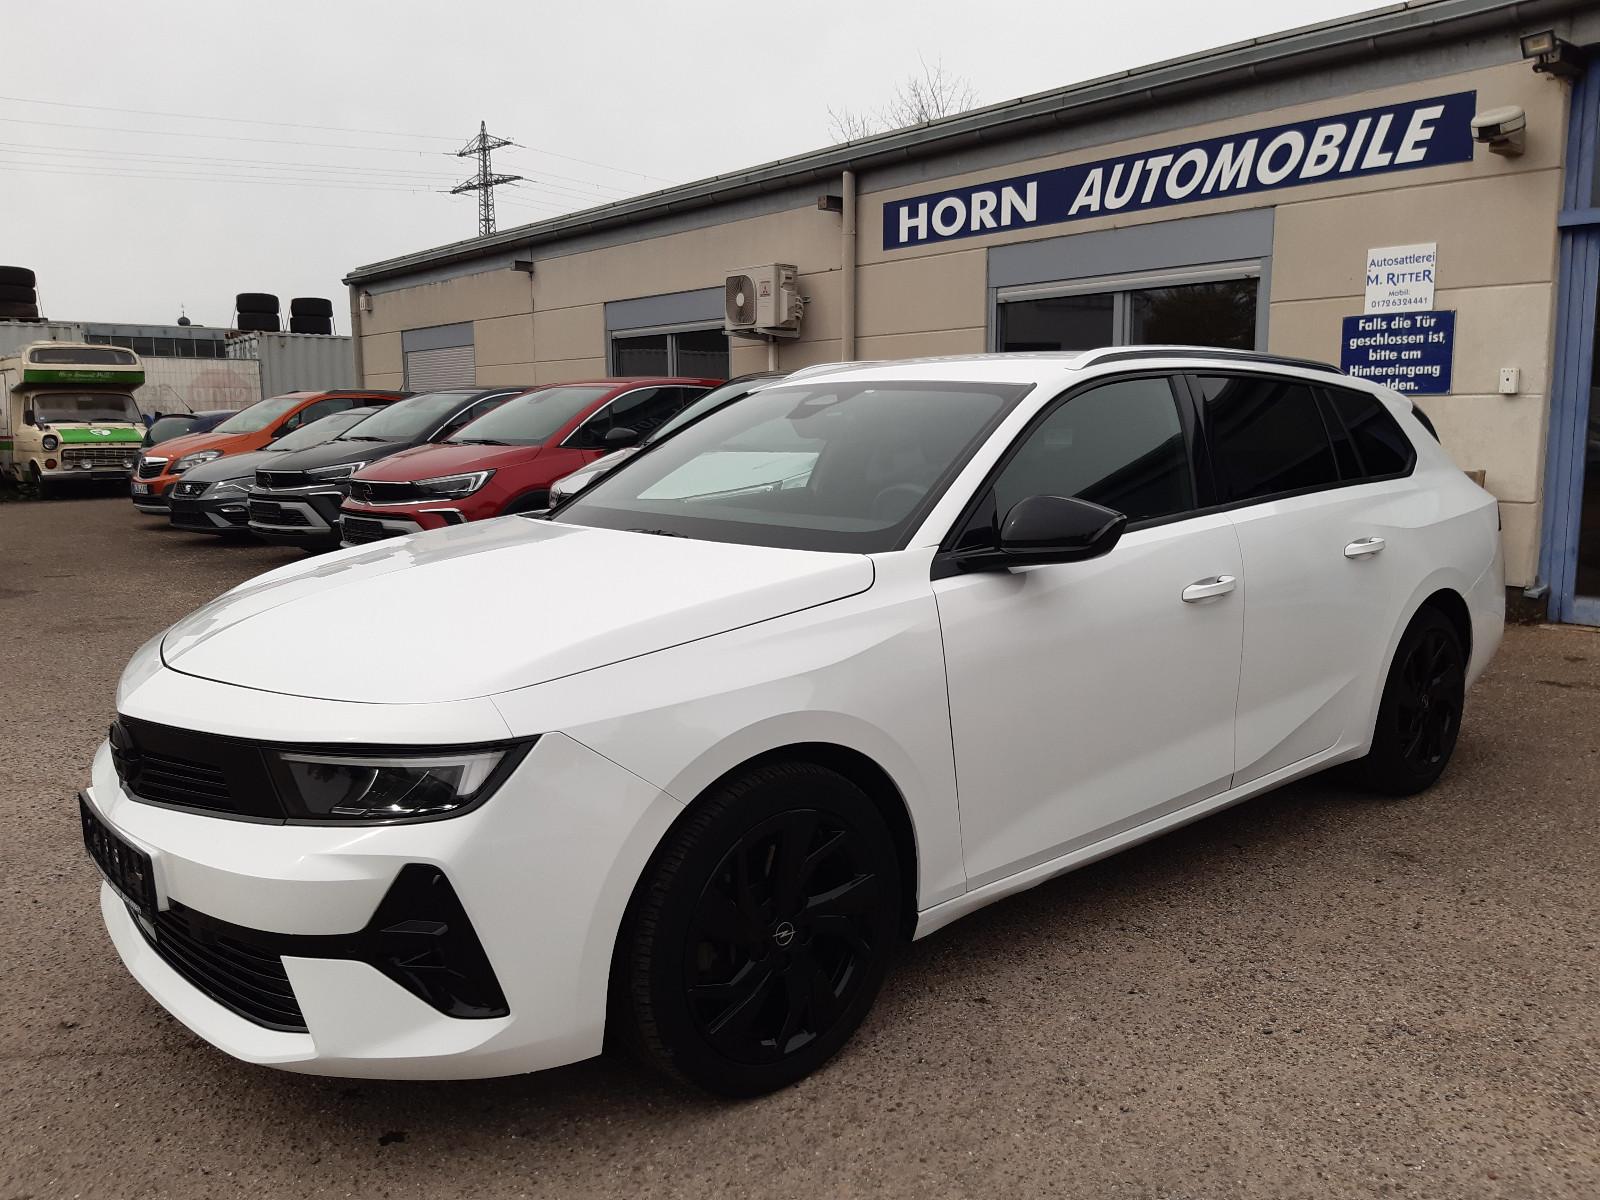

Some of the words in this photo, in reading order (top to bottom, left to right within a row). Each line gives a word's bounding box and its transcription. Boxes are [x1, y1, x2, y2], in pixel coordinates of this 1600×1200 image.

[898, 181, 1038, 243] HORN
[1067, 104, 1445, 216] AUTOMOBILE
[1368, 251, 1436, 268] Autosattlerei
[1366, 274, 1383, 287] M.
[1386, 269, 1434, 287] RITTER
[1358, 317, 1388, 331] Falls
[1390, 316, 1412, 329] die
[1415, 315, 1437, 328] Tür
[1349, 332, 1424, 349] geschlossen
[1428, 331, 1446, 344] ist,
[1368, 348, 1398, 361] bitte
[1401, 350, 1422, 360] am
[1349, 363, 1441, 378] Hintereingang
[1378, 378, 1419, 391] lden.
